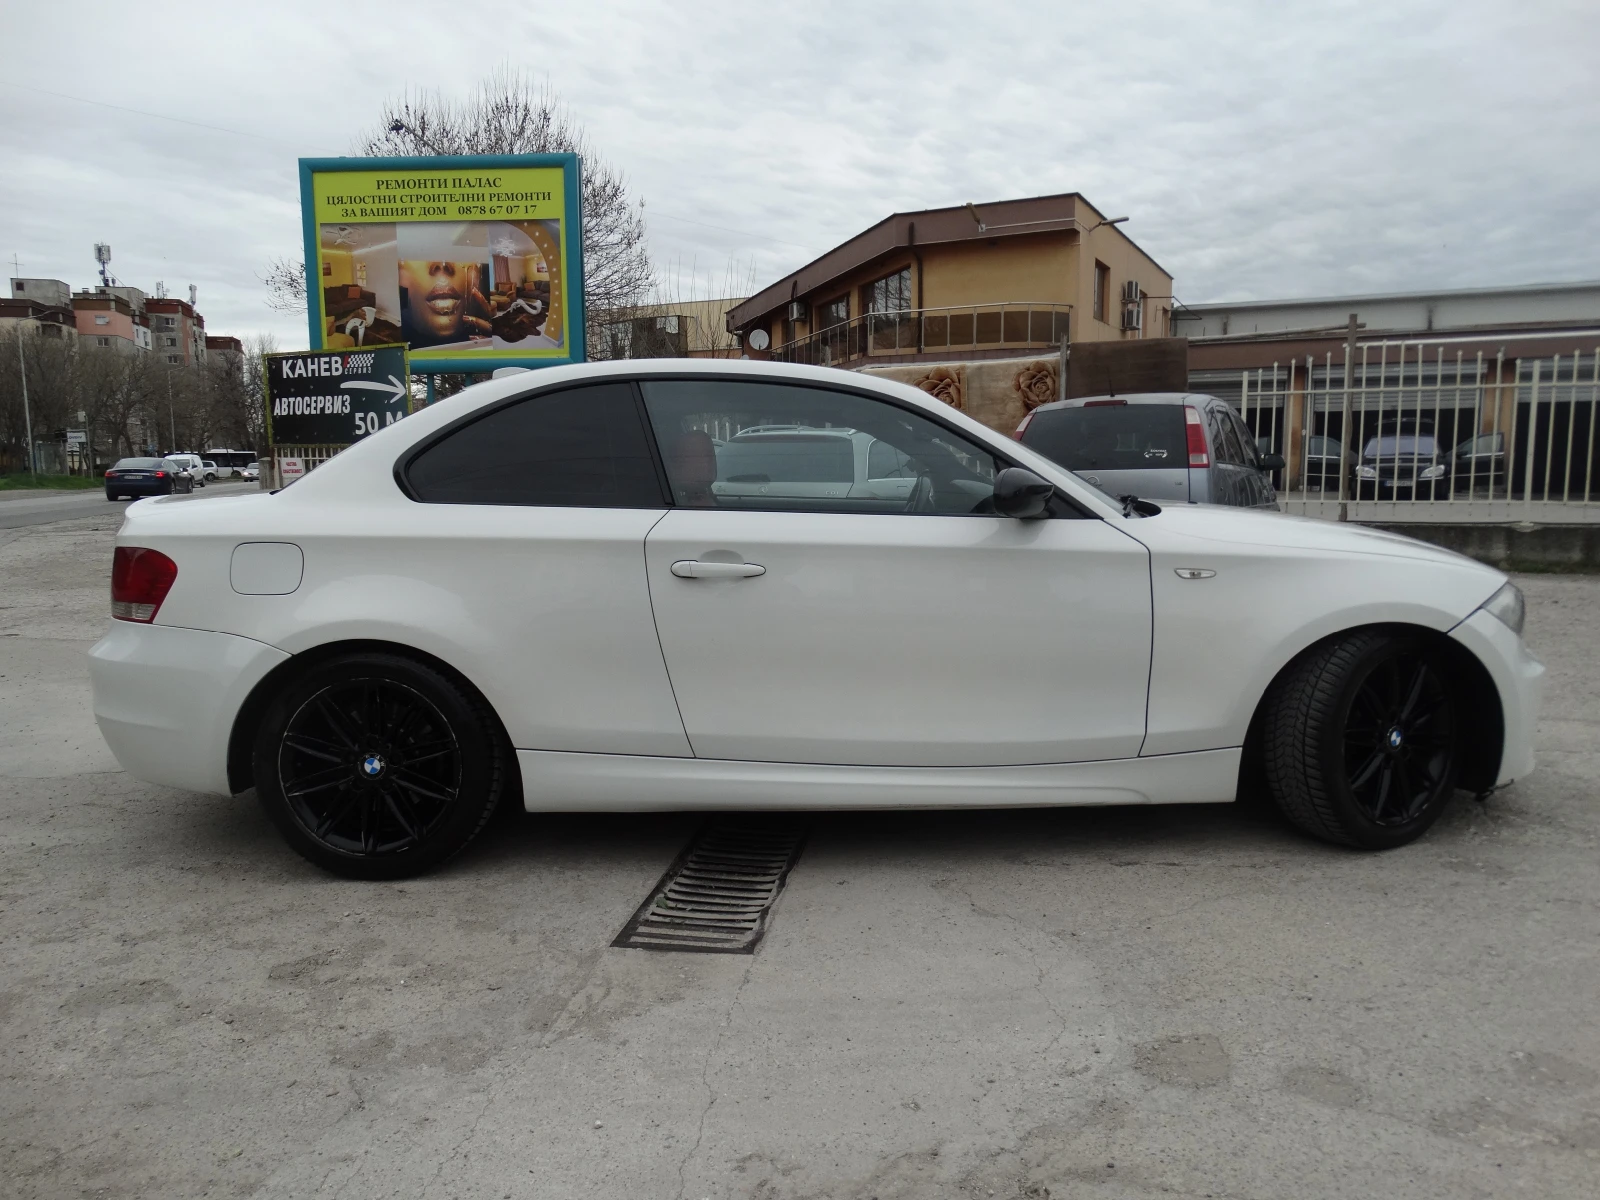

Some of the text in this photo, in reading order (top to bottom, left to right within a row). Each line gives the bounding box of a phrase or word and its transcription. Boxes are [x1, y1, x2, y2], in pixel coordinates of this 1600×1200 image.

[376, 177, 502, 190] РЕМОНТИ ПАЛАС
[326, 191, 552, 206] ЦЯЛОСТНИ СТРОИТЕЛНИ РЕМОНТИ
[341, 204, 537, 217] ЗА ВАШИЯТ ДОМ 0878 67 07 17
[282, 356, 343, 378] КАНЕВ
[273, 394, 350, 416] АВТОСЕРВИЗ
[355, 411, 379, 435] 50
